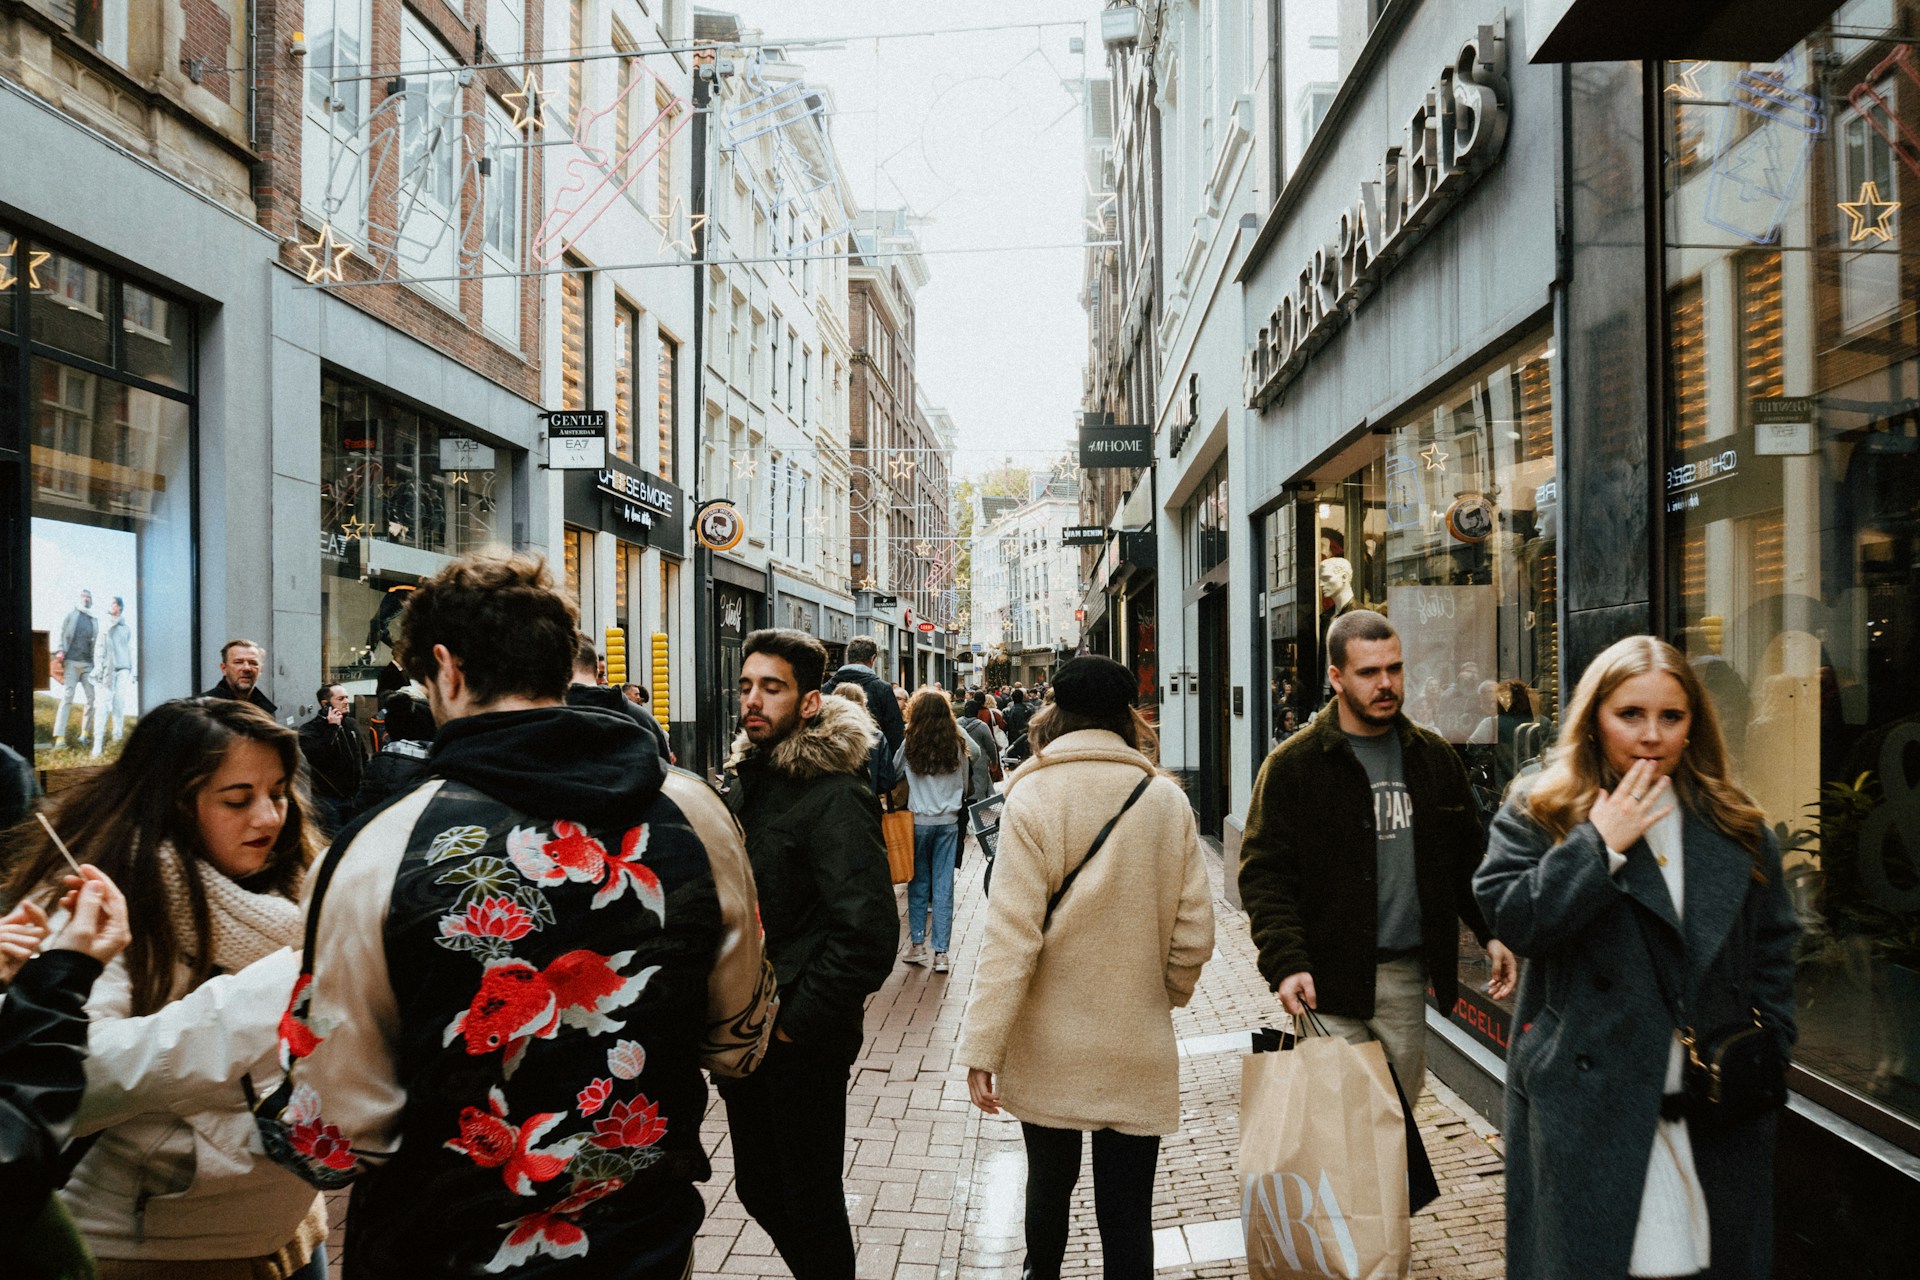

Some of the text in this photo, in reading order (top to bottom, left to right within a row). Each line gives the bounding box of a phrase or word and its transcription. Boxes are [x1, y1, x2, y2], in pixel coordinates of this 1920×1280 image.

[551, 413, 604, 426] GENTLE
[565, 439, 590, 449] EA7
[1105, 439, 1143, 452] HOME
